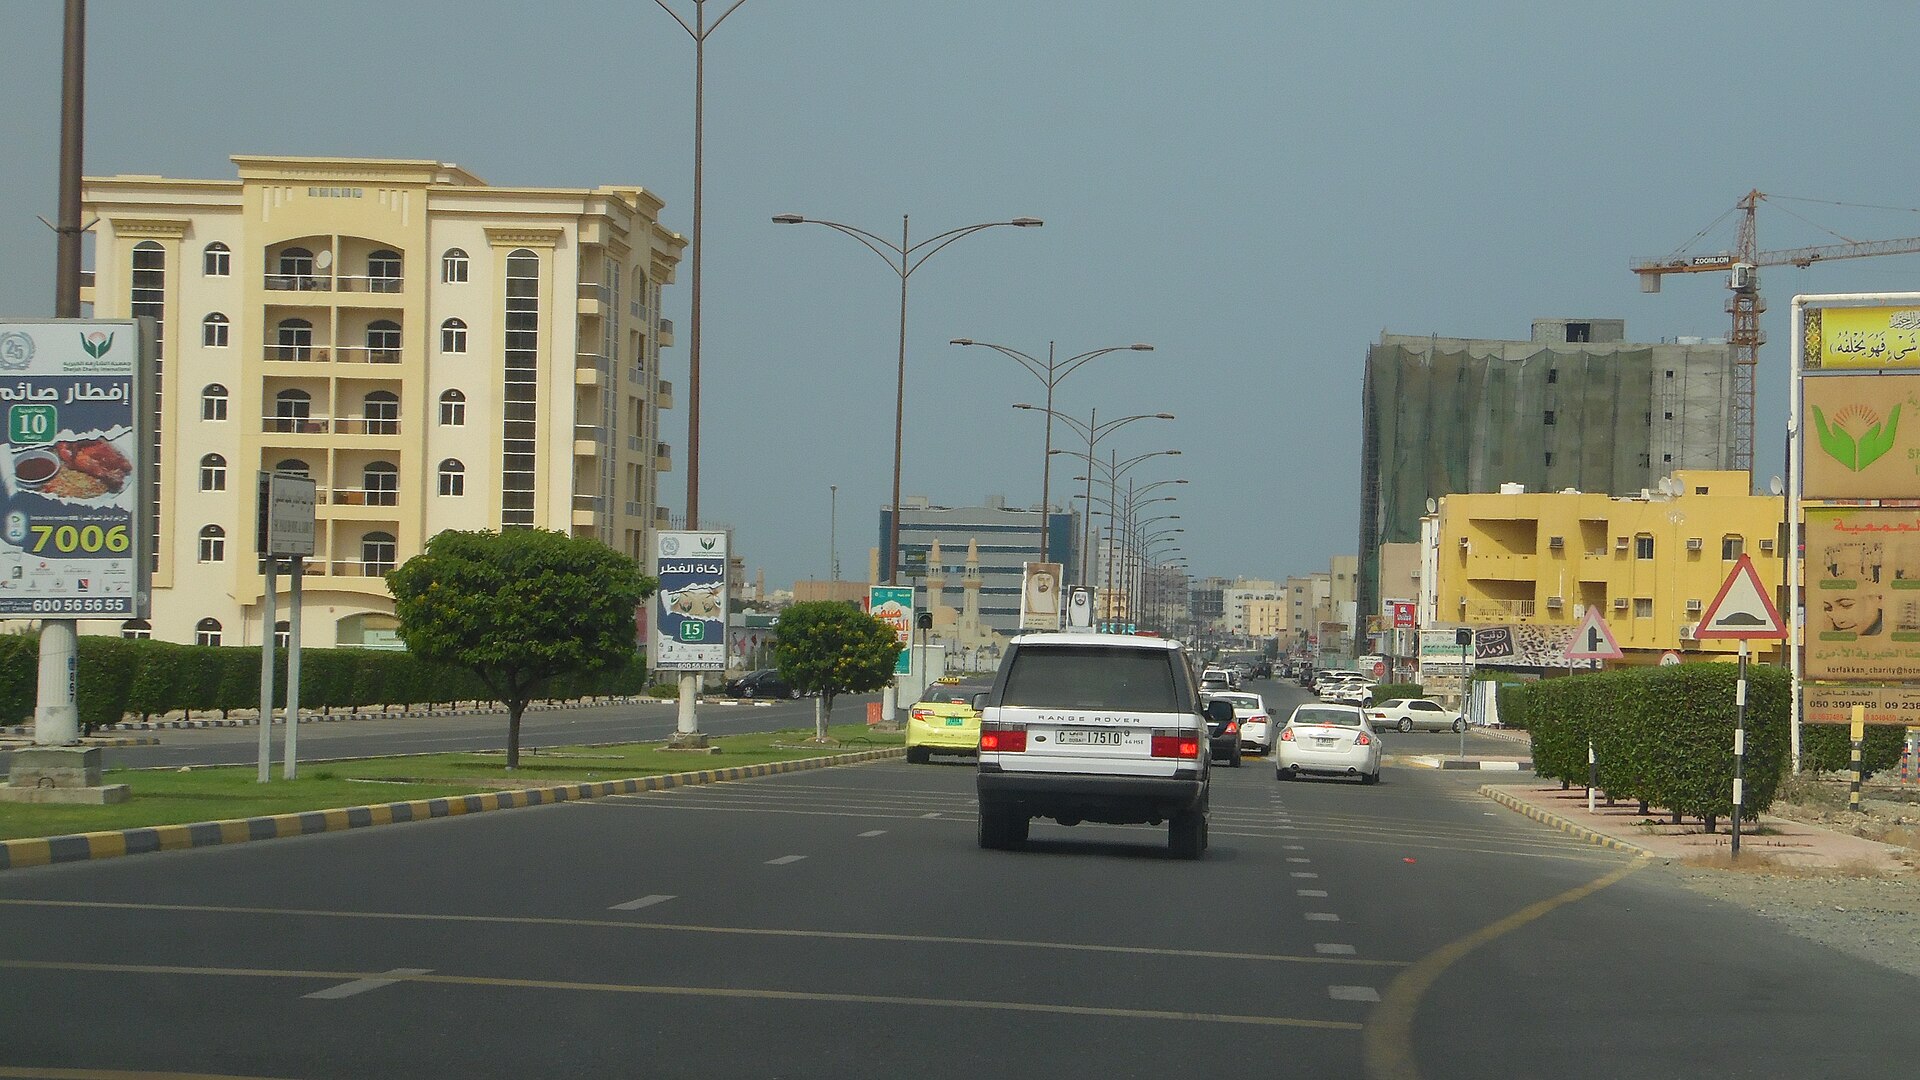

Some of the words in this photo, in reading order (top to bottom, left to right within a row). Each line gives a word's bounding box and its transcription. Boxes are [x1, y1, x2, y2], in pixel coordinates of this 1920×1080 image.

[1695, 256, 1729, 264] ZOOMLION
[0, 382, 58, 401] صائم
[65, 383, 129, 405] إفطار
[19, 414, 47, 434] 10
[31, 525, 129, 553] 7006
[660, 563, 694, 575] الفطر
[696, 564, 723, 576] زكاة
[33, 600, 61, 611] 600
[64, 600, 82, 611] 56
[84, 600, 102, 611] 56
[105, 600, 124, 611] 55
[685, 624, 700, 636] 15
[1810, 701, 1829, 709] 050
[1885, 702, 1898, 710] 09
[1060, 732, 1064, 742] C
[1088, 732, 1119, 744] 17510
